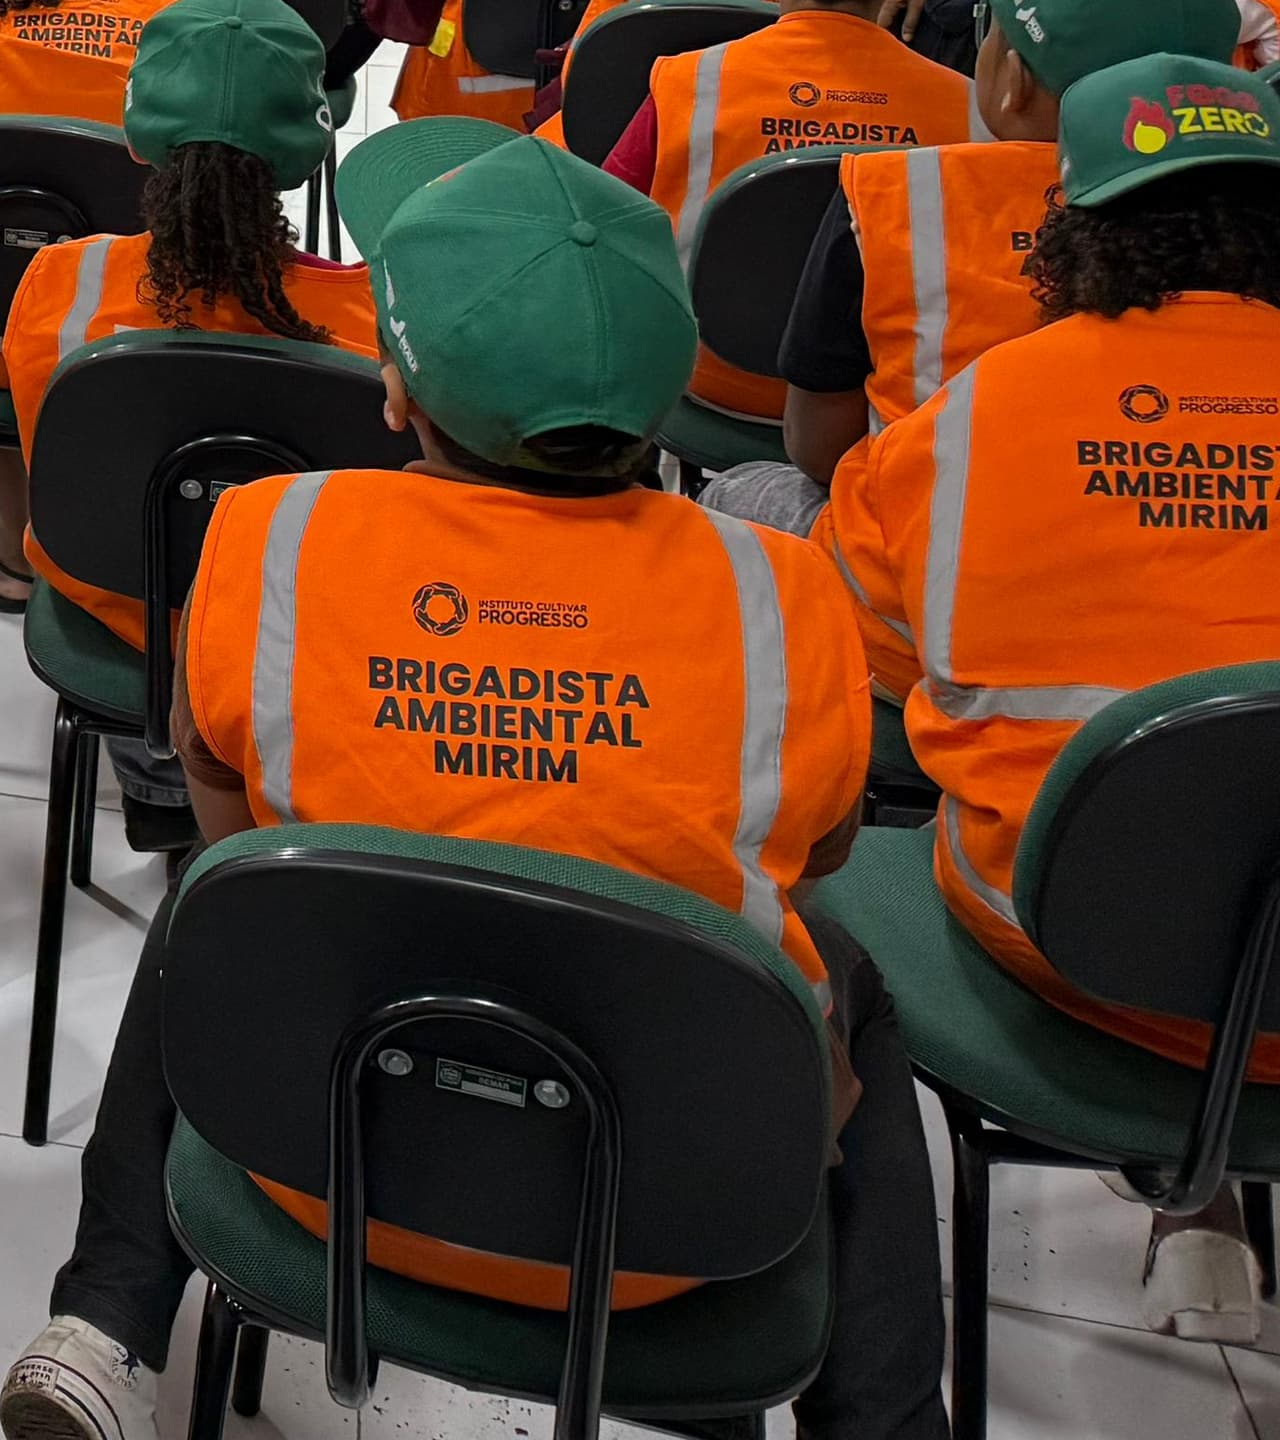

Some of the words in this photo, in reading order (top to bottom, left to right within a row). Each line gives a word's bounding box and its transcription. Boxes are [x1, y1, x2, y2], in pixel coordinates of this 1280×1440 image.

[14, 12, 143, 31] BRIGADISTA
[826, 94, 888, 105] PROGRESSO
[761, 117, 919, 145] BRIGADISTA
[1172, 106, 1270, 138] ZERO
[1179, 402, 1279, 415] PROGRESSO
[1077, 440, 1280, 472] BRIGADIS
[1083, 469, 1280, 501] AMBIENT
[1140, 501, 1268, 531] MIRIM
[478, 600, 533, 611] INSTITUTO
[536, 602, 587, 613] CULTIVAR
[478, 610, 589, 629] PROGRESSO
[368, 656, 650, 708] BRIGADISTA
[374, 696, 642, 748] AMBIENTAL
[434, 740, 578, 783] MIRIM
